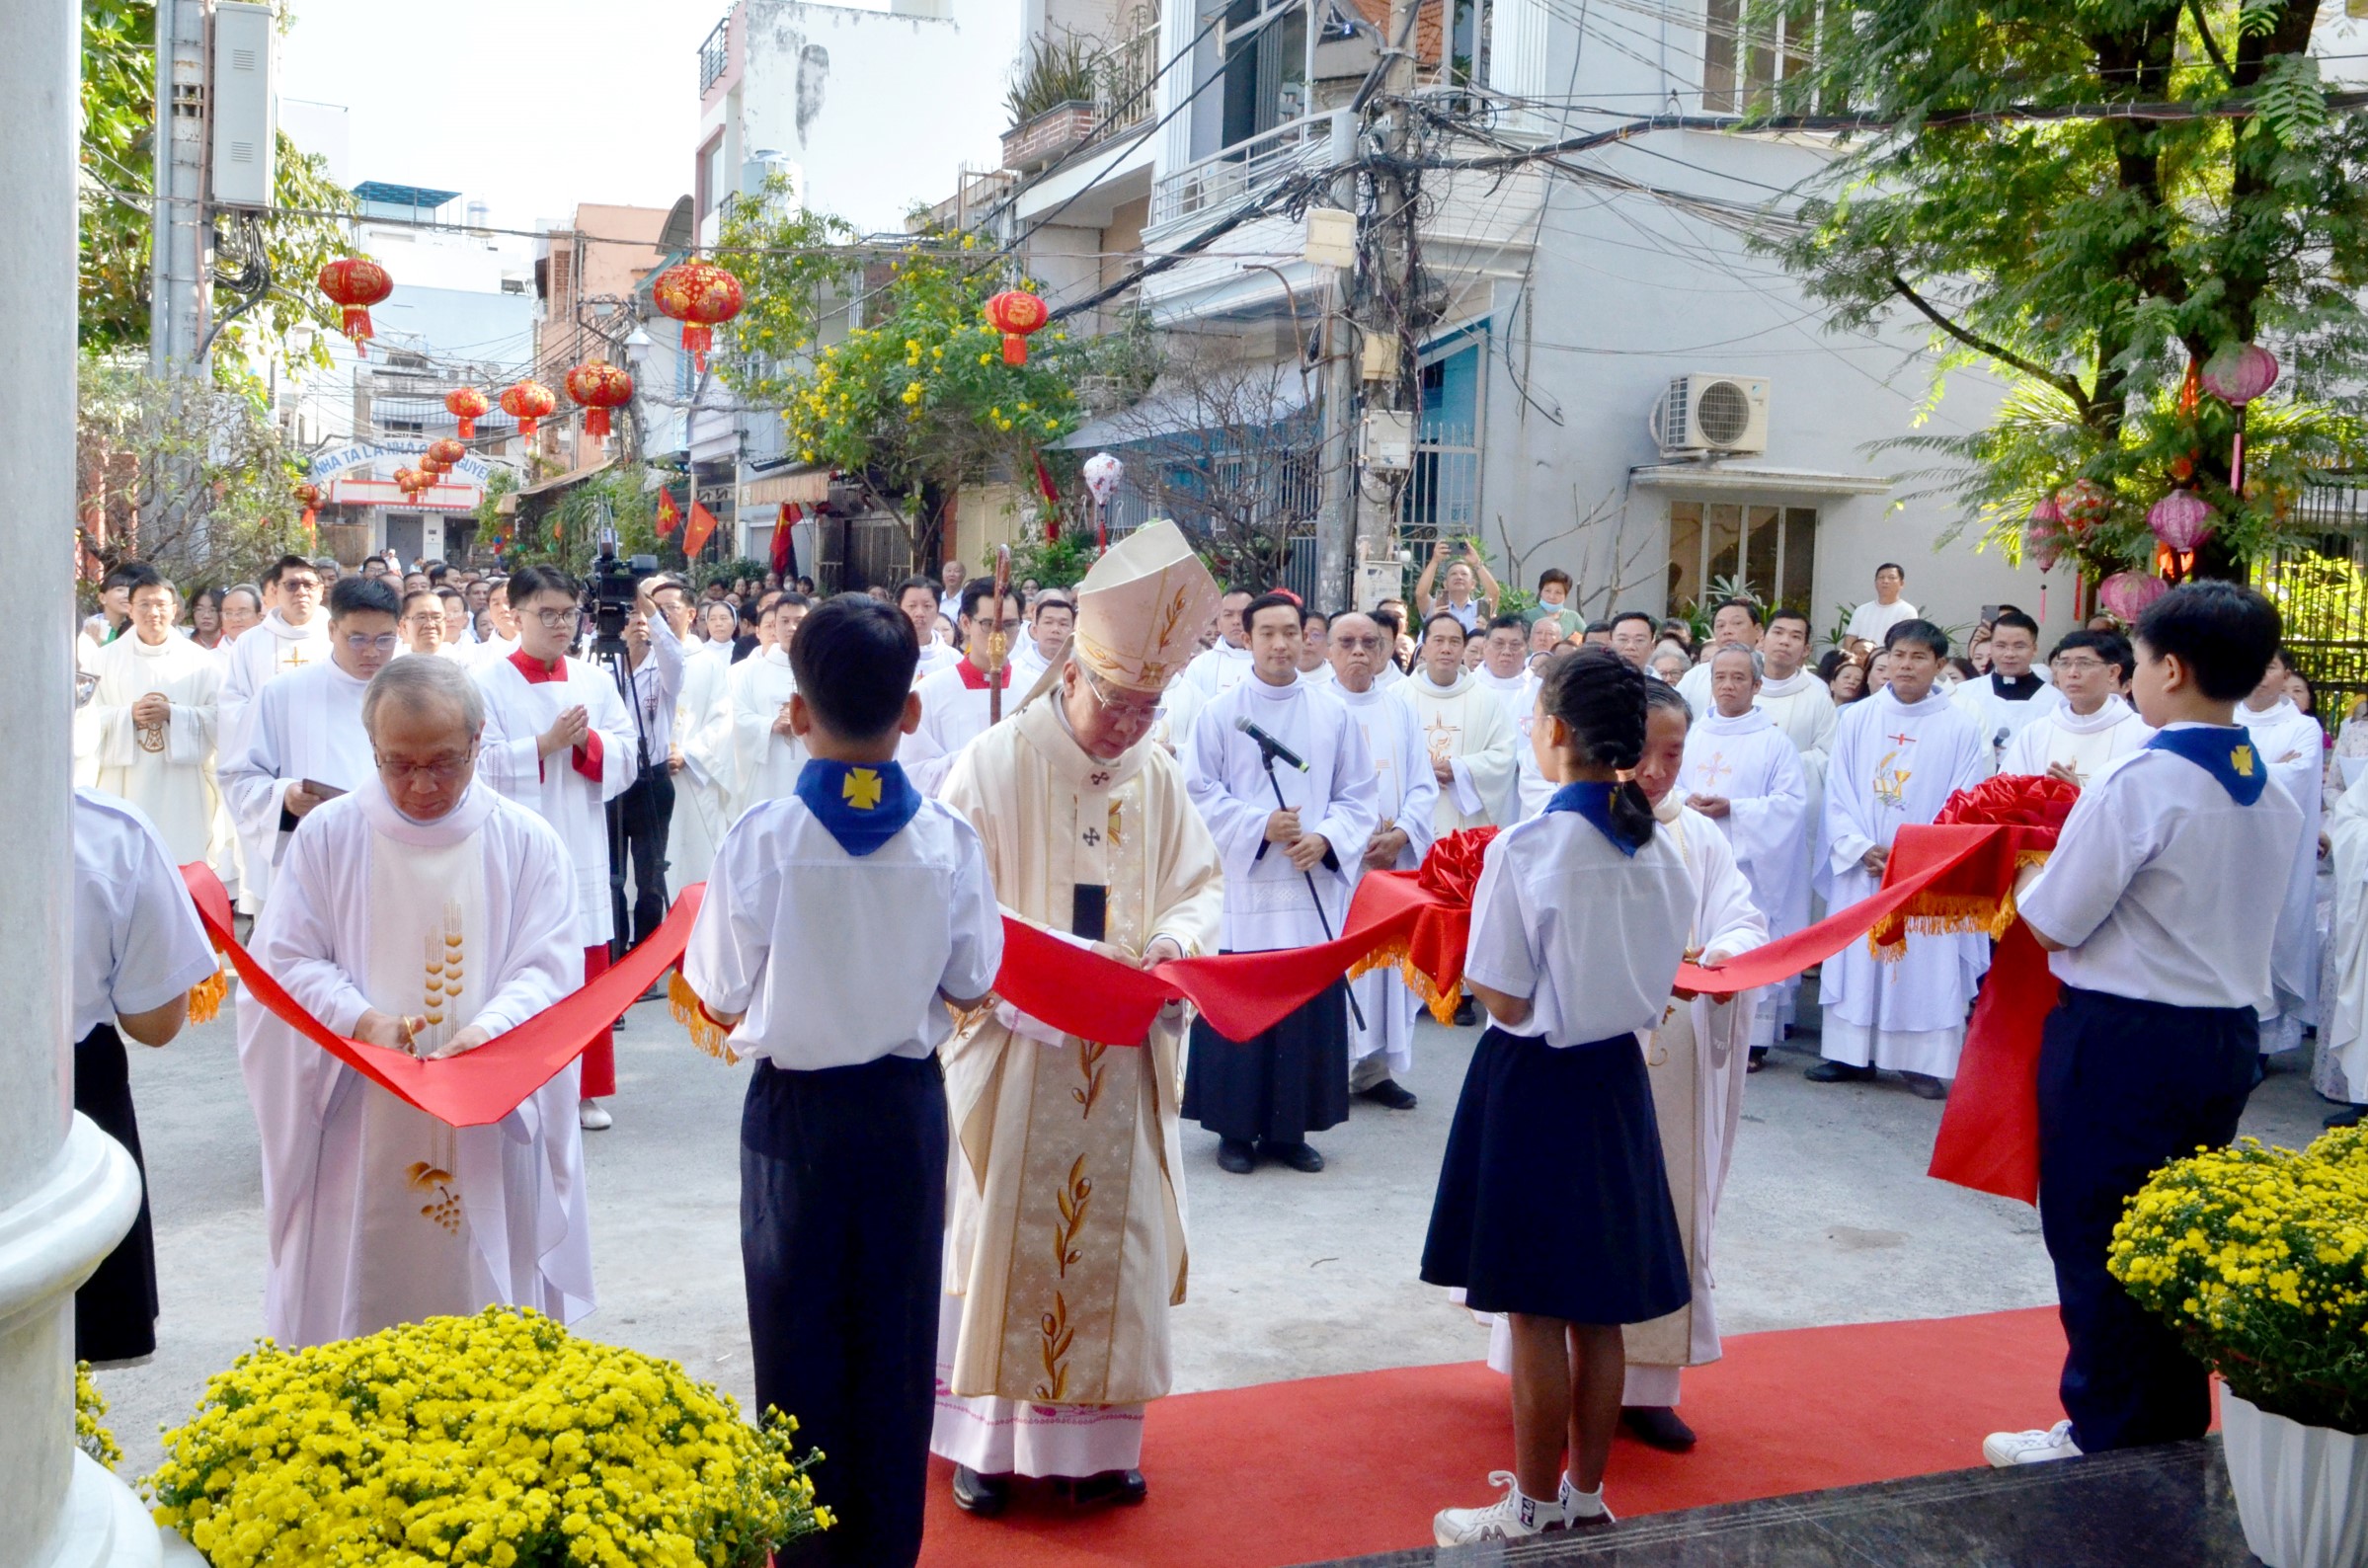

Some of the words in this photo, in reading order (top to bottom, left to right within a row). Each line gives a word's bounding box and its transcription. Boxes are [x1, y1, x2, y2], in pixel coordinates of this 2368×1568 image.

[1344, 23, 1351, 35] 2
[341, 447, 361, 464] TA
[1522, 1499, 1535, 1527] FILA
